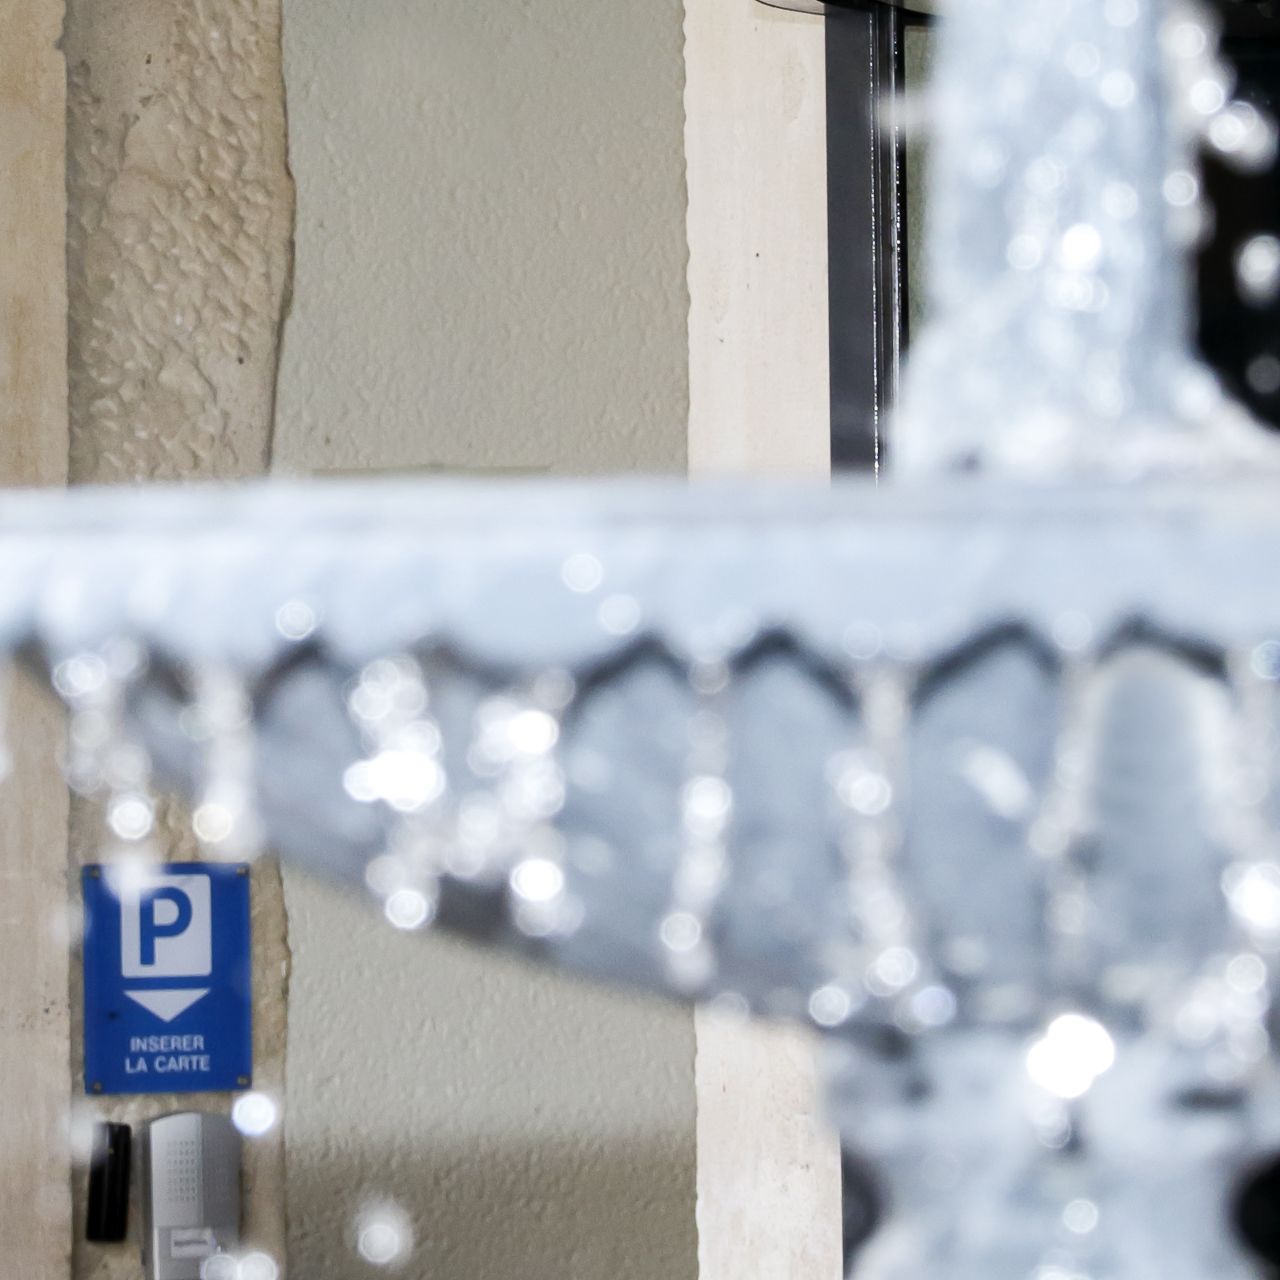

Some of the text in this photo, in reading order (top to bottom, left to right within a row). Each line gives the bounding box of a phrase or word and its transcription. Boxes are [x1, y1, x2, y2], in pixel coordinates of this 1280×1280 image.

[129, 1034, 205, 1053] INSERER
[124, 1054, 210, 1074] LA CARTE
